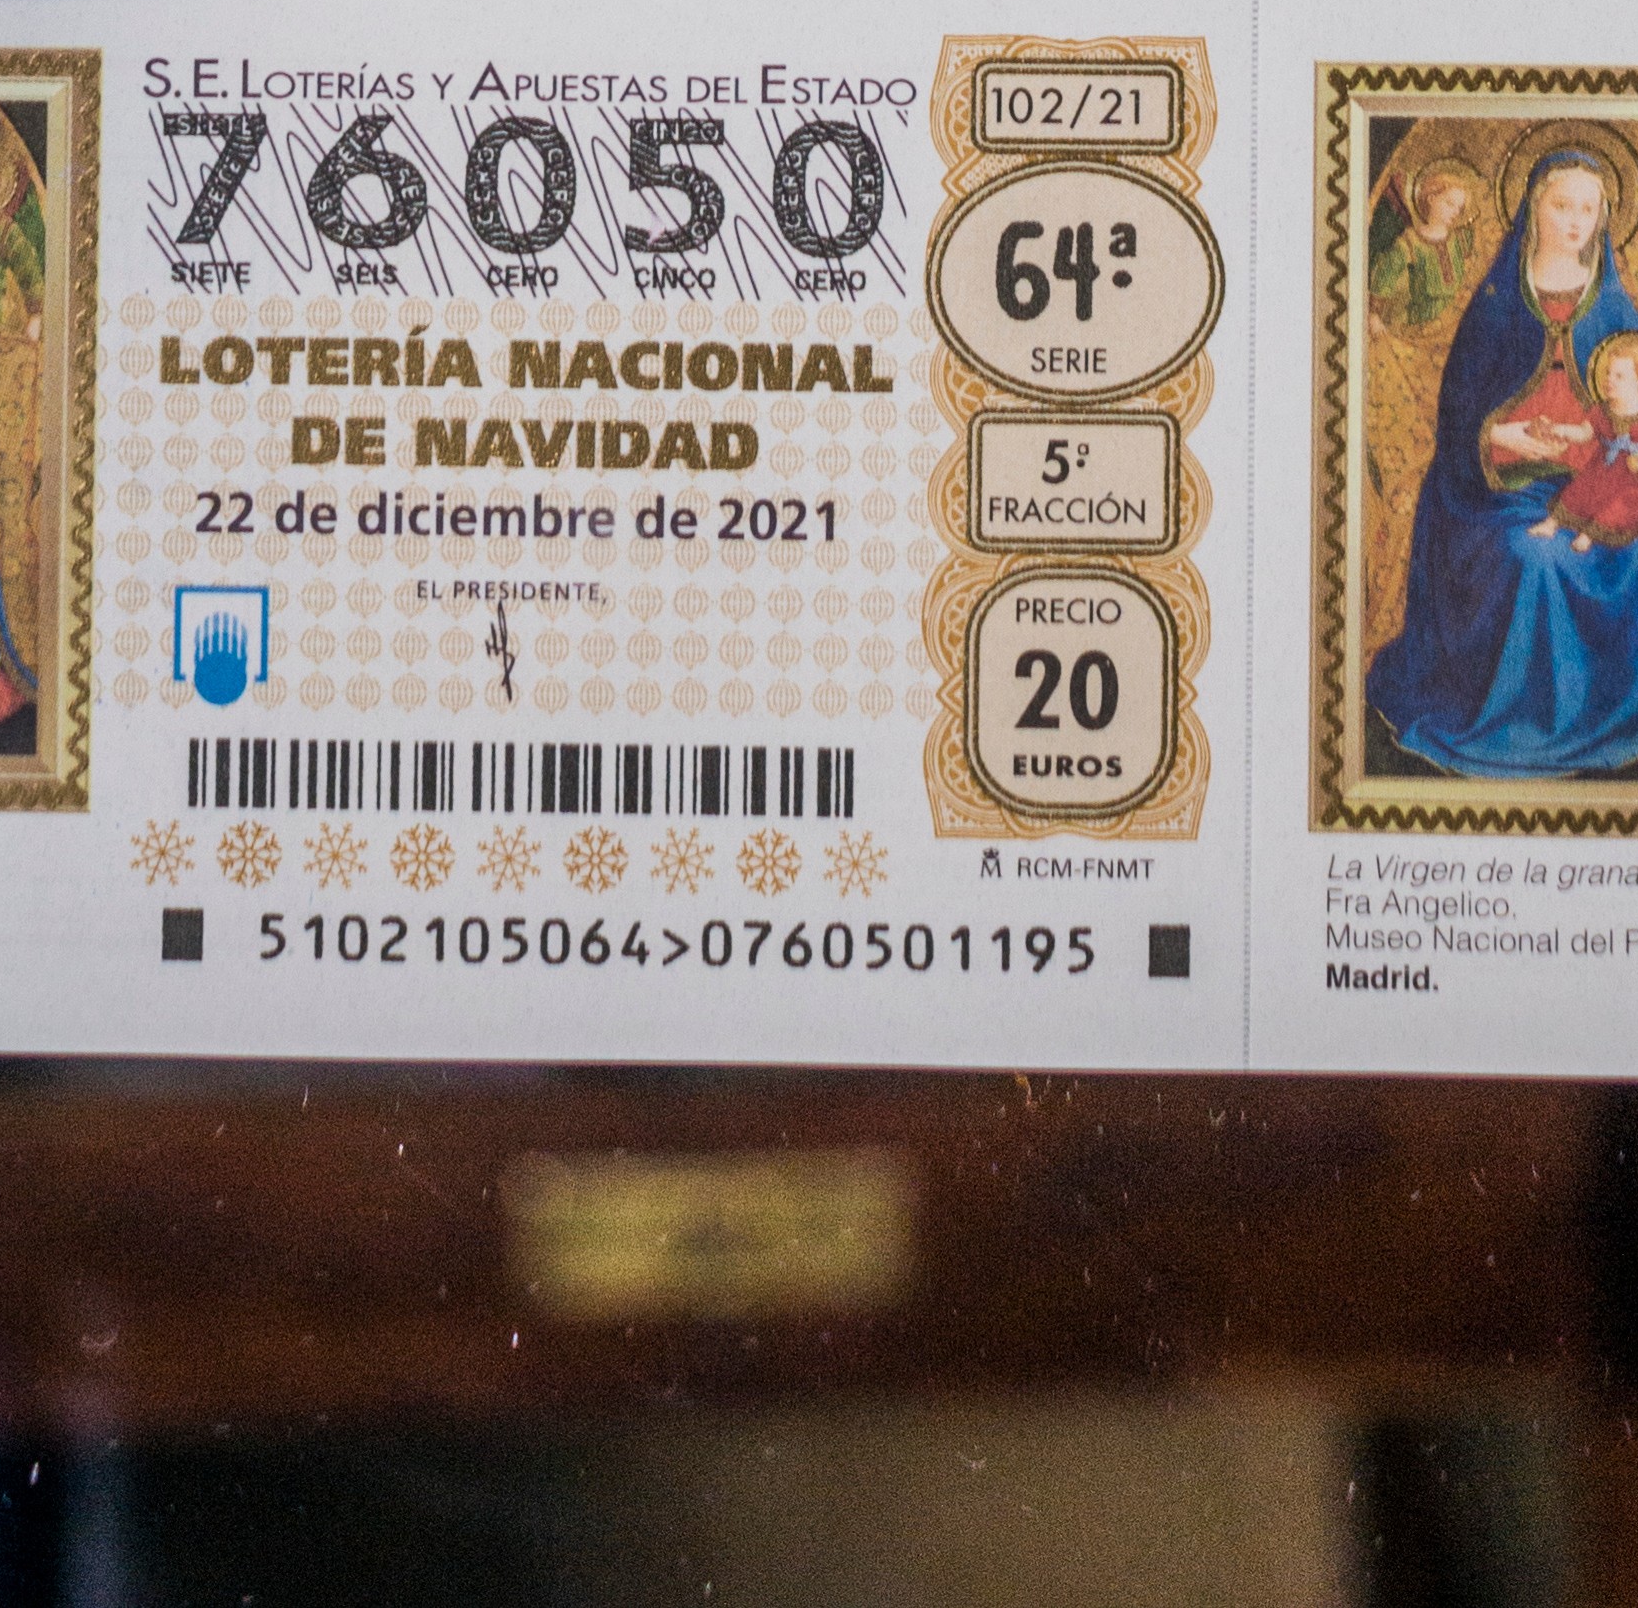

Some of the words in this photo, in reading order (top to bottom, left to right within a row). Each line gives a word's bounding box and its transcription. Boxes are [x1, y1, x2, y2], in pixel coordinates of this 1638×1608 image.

[991, 84, 1142, 131] 102/21
[162, 111, 885, 262] 76050
[156, 323, 482, 389] LOTERÍA
[507, 337, 894, 396] NACIONAL
[290, 415, 386, 467] DE
[414, 417, 760, 473] NAVIDAD
[194, 490, 256, 534] 22
[275, 490, 338, 535] de
[356, 491, 616, 540] diciembre
[635, 496, 700, 540] de
[717, 497, 837, 542] 2021
[260, 913, 1095, 974] 5102105064>0760501195
